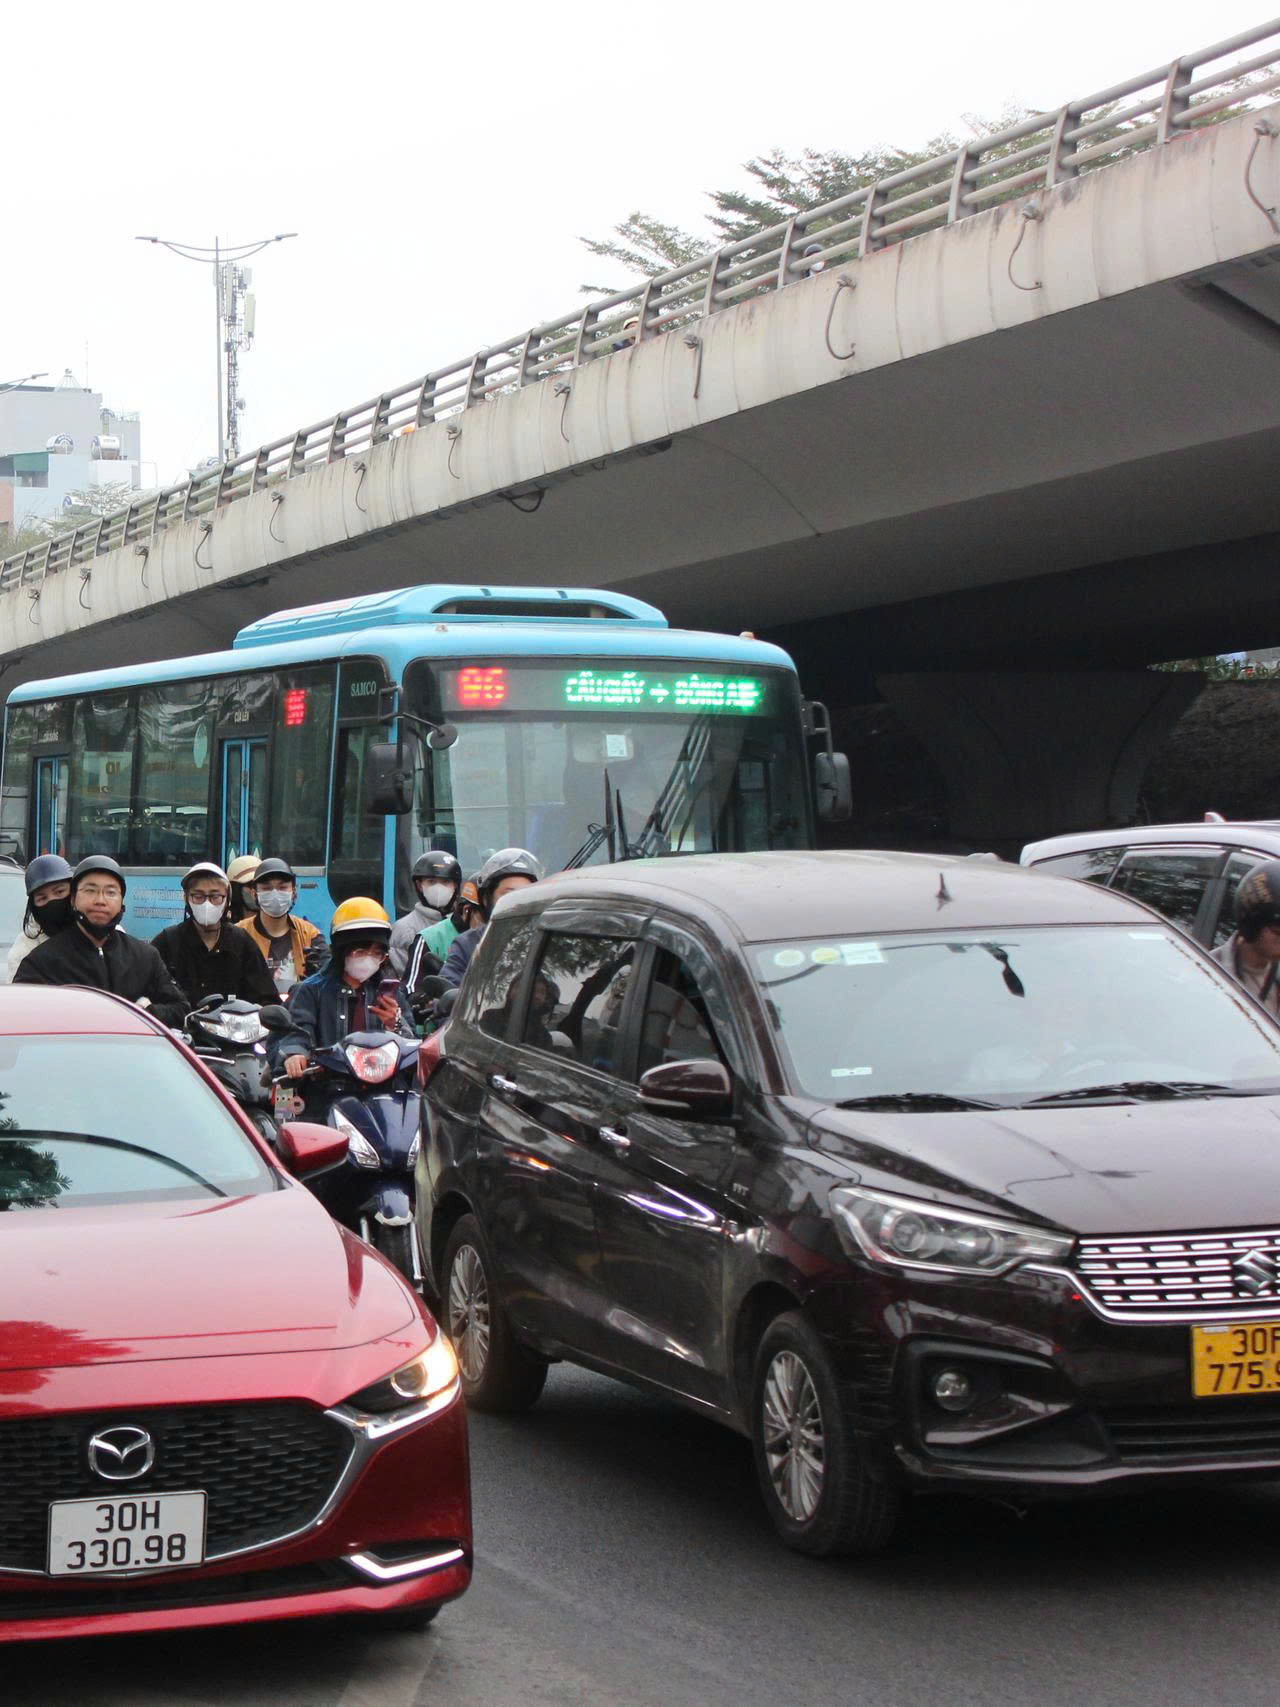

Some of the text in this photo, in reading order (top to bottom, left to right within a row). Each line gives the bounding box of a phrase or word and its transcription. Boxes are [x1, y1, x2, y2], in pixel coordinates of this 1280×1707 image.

[350, 681, 377, 697] SAMCO
[95, 1500, 161, 1534] 30H
[66, 1533, 187, 1570] 330.98
